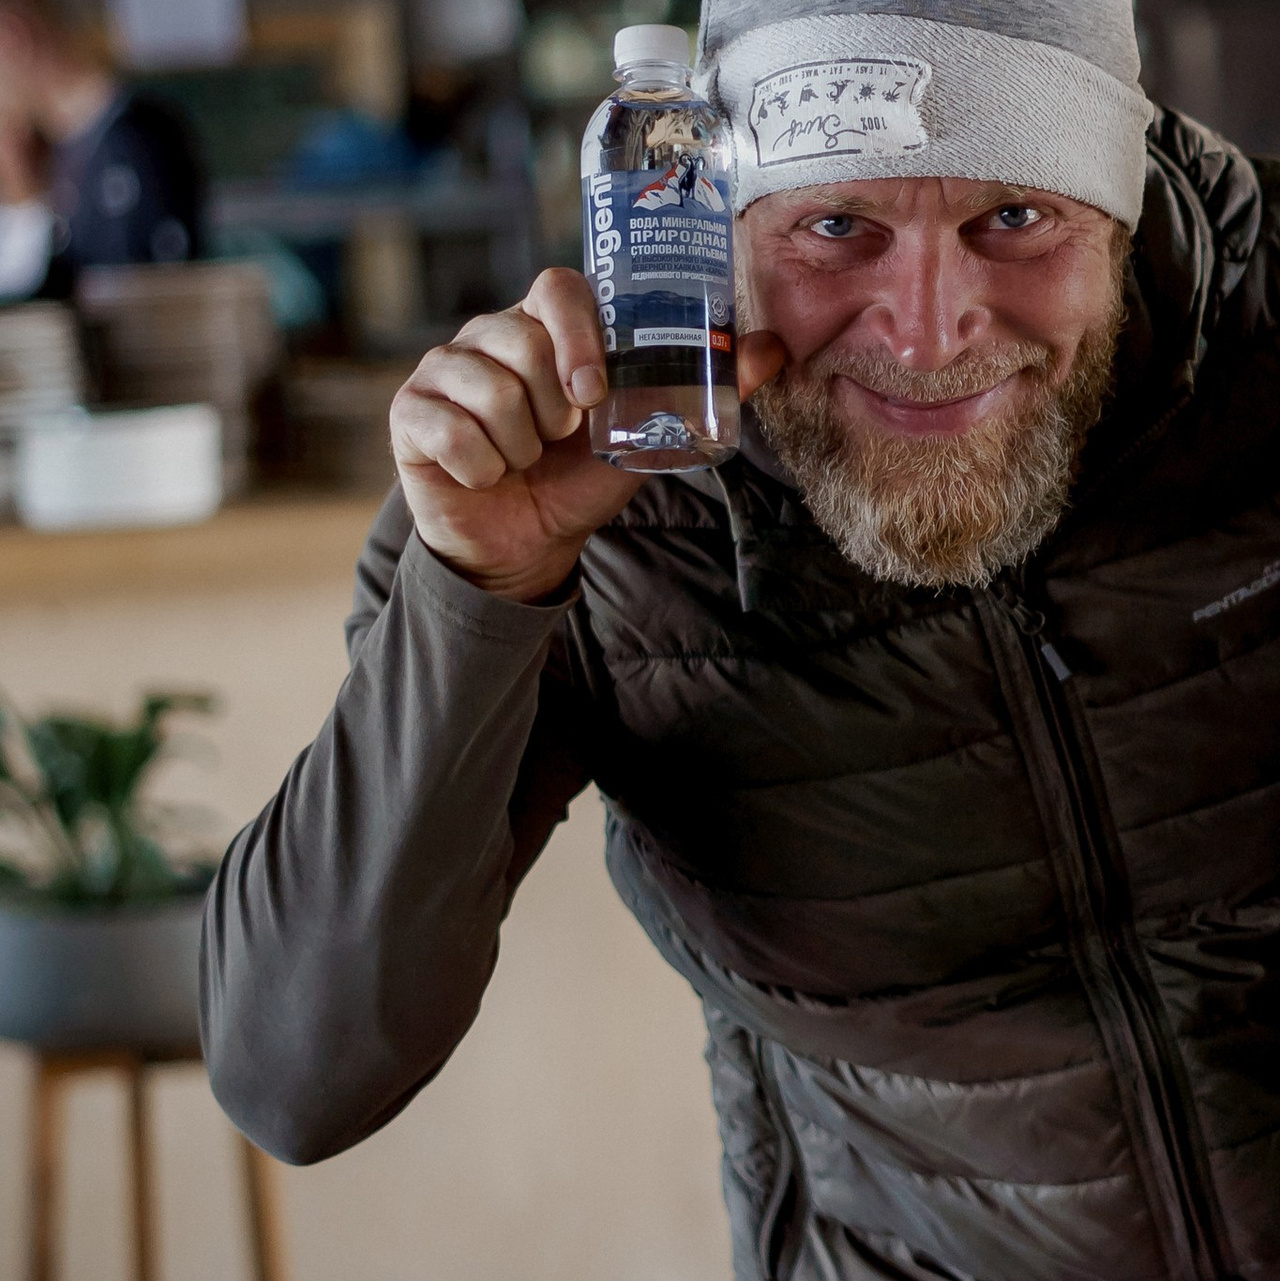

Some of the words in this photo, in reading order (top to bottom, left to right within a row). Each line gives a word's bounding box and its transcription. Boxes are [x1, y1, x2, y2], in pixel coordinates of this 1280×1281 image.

[829, 66, 843, 75] EAT
[772, 114, 867, 151] Surf
[629, 217, 660, 230] ВОДА
[661, 217, 727, 235] МИНЕРАЛЬНАЯ
[630, 229, 727, 250] ПРИРОДНАЯ
[630, 244, 686, 256] СТОЛОВАЯ
[688, 245, 728, 262] ПИТЬЕВАЯ
[638, 332, 703, 341] НЕГАЗИРОВАННАЯ
